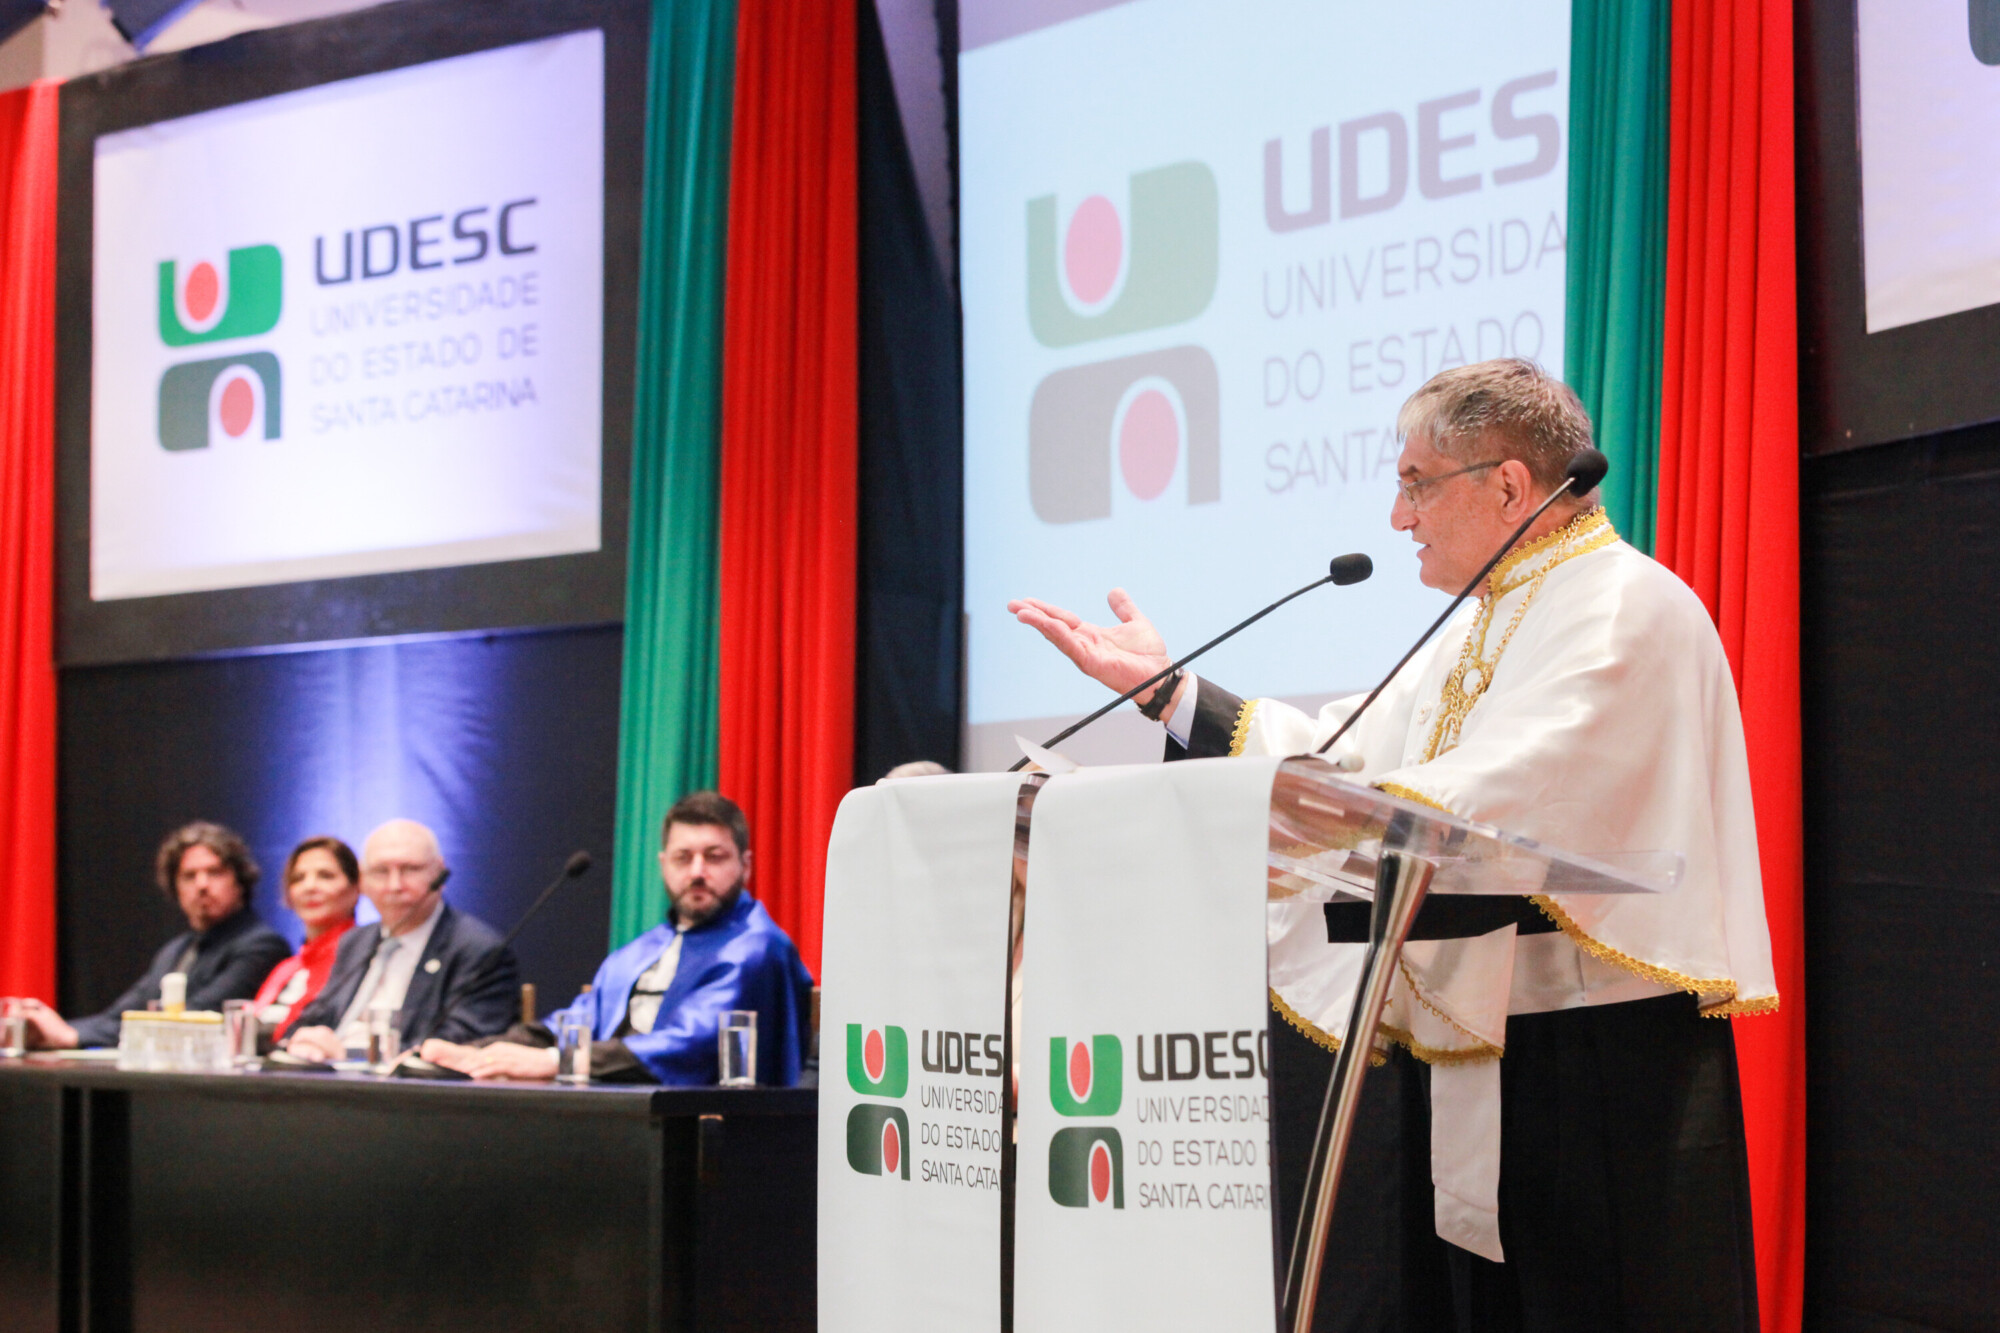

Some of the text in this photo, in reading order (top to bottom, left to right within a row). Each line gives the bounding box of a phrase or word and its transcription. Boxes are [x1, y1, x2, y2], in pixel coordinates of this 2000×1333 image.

[1264, 70, 1560, 235] UDES
[315, 198, 537, 286] UDESC
[1263, 210, 1567, 320] UNIVERSIDA
[310, 270, 539, 338] UNIVERSIDADE
[311, 322, 539, 386] DO ESTADO DE
[1265, 310, 1543, 408] DO ESTADO
[311, 375, 540, 435] SANTA CATARINA
[1265, 427, 1398, 494] SANTA
[921, 1029, 1003, 1078] UDES
[921, 1122, 1001, 1153] DO ESTADO
[1138, 1140, 1163, 1166] DO
[1173, 1140, 1257, 1166] ESTADO
[921, 1159, 1001, 1191] SANTA CATA
[1139, 1182, 1202, 1209] SANTA
